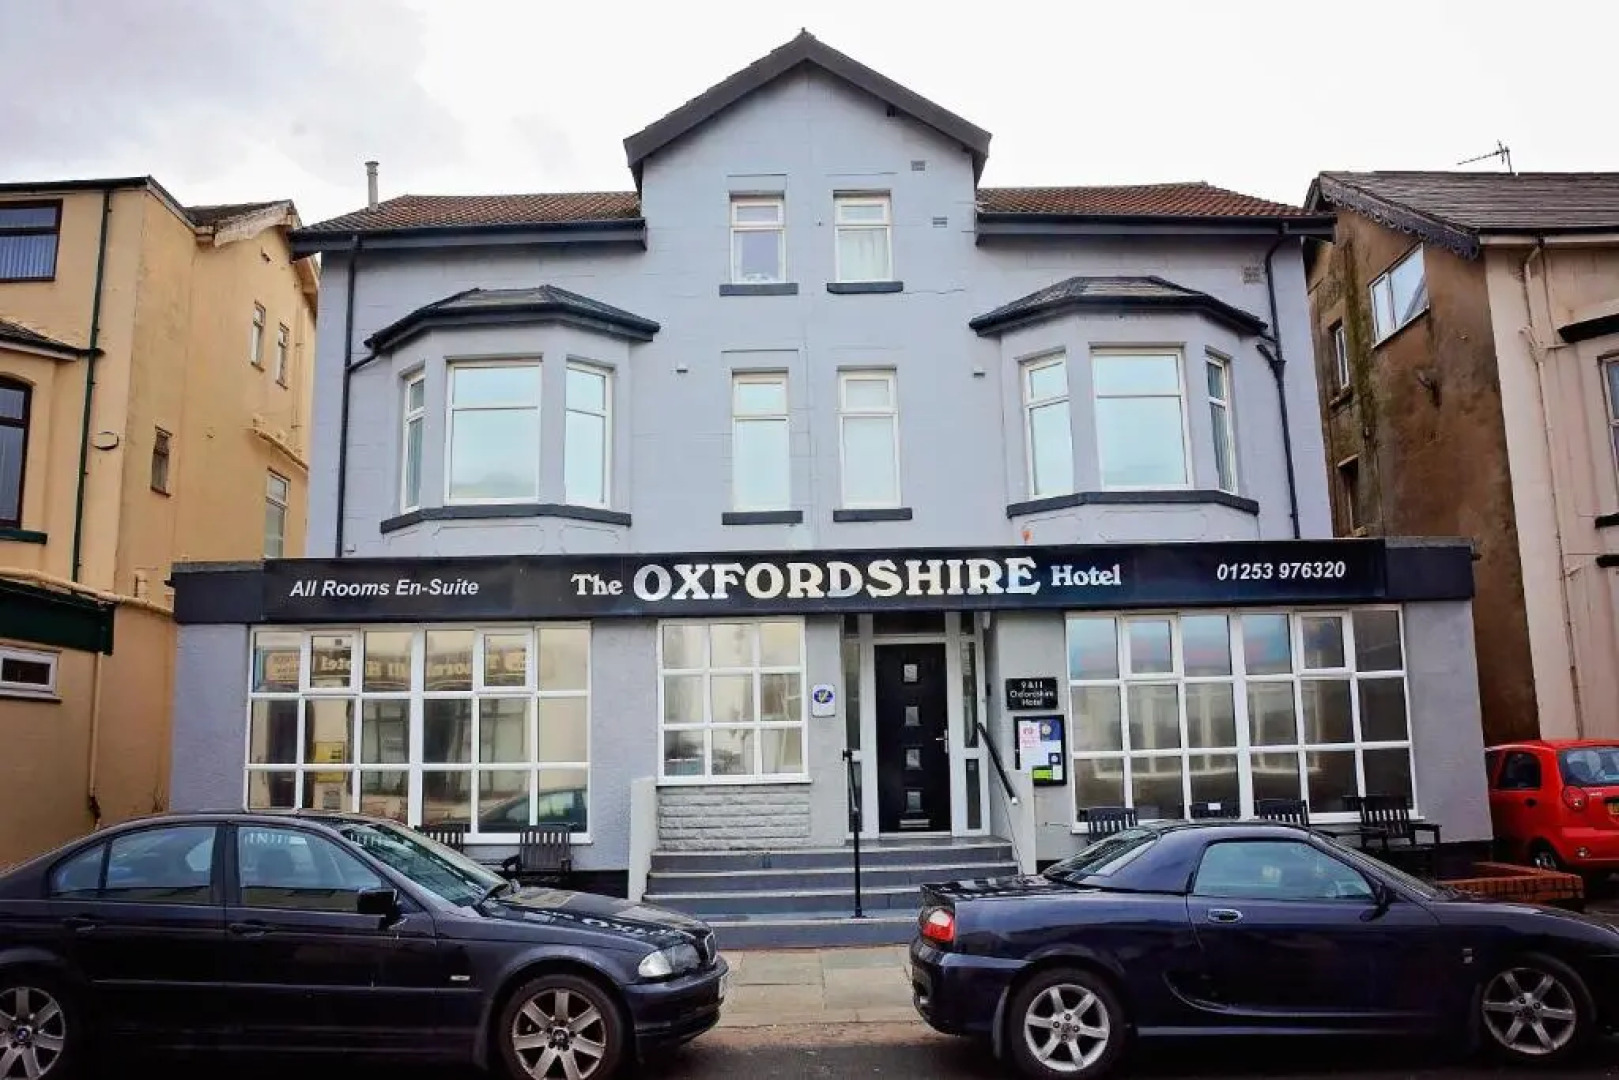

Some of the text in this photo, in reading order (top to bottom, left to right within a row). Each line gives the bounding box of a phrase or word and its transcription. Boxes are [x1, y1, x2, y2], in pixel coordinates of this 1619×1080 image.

[570, 557, 1122, 601] The OXFORDSHIRE Hotel
[1216, 560, 1346, 581] 01253 976320
[289, 578, 480, 597] All Rooms En-Suite
